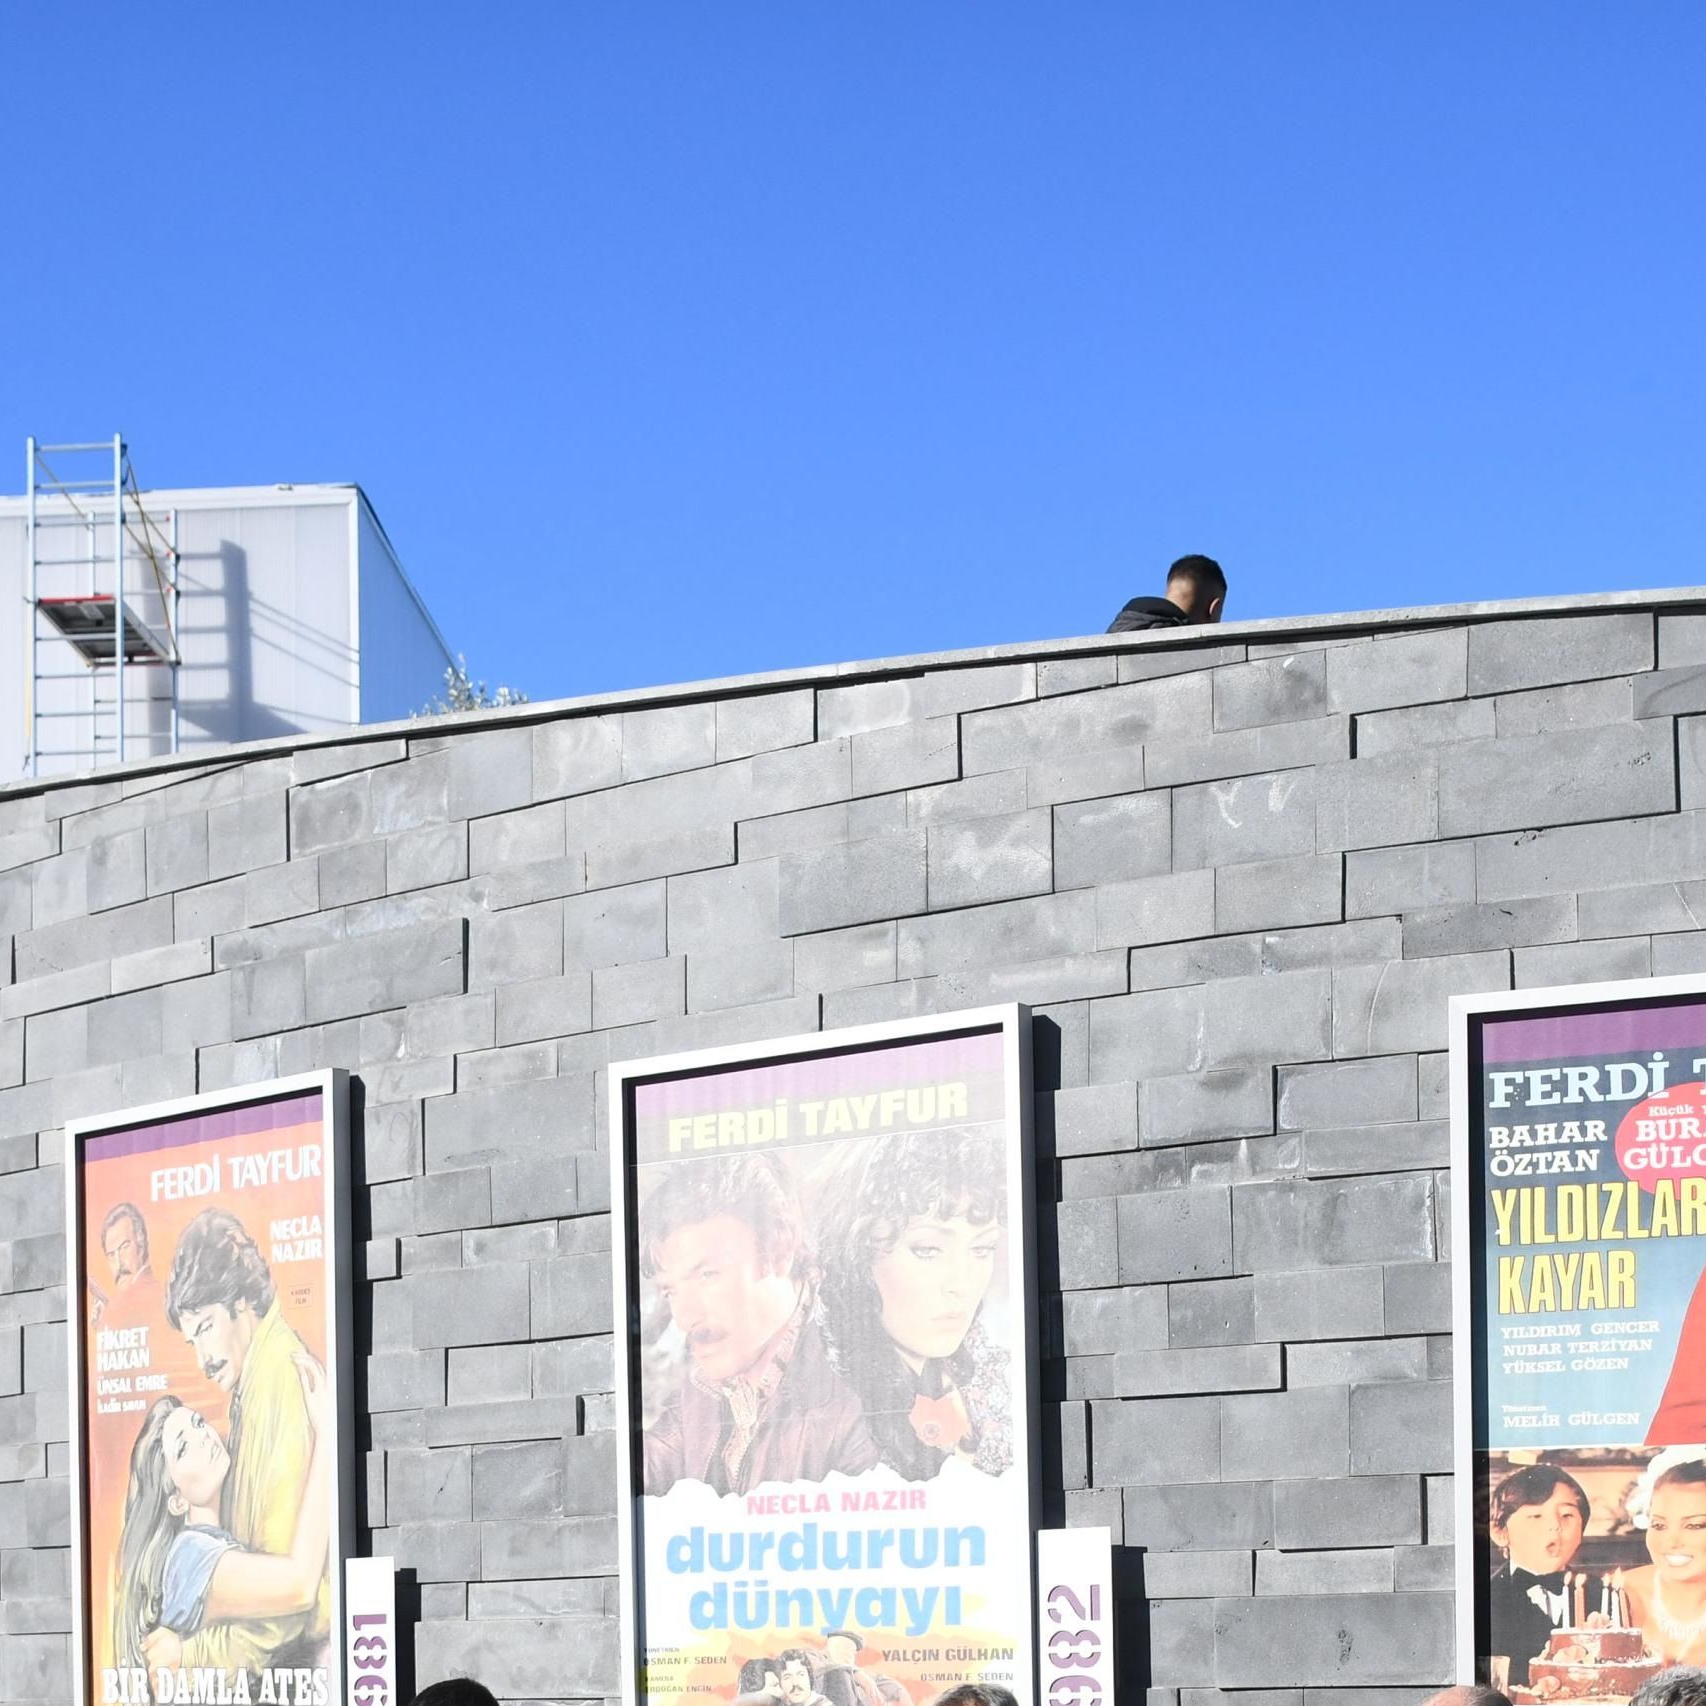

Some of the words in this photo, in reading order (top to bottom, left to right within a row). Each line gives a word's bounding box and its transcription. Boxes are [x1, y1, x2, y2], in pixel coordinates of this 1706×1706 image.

[1489, 1051, 1669, 1108] FERDİ
[669, 1099, 788, 1153] FERDİ
[799, 1082, 968, 1136] TAYFUR
[1648, 1103, 1694, 1117] Küçük
[1489, 1120, 1607, 1149] BAHAR
[151, 1153, 220, 1202] FERDİ
[228, 1144, 322, 1189] TAYFUR
[1490, 1147, 1598, 1177] ÖZTAN
[270, 1215, 323, 1241] NECLA
[271, 1238, 324, 1264] NAZIR
[1498, 1250, 1637, 1315] KAYAR
[97, 1324, 149, 1351] FİKRET
[1500, 1323, 1581, 1339] YILDIRIM
[97, 1347, 149, 1372] HAKAN
[1503, 1343, 1562, 1357] NUBAR
[1567, 1338, 1653, 1354] TERZİYAN
[1502, 1360, 1565, 1374] YÜKSEL
[1571, 1357, 1629, 1371] GÖZEN
[97, 1375, 132, 1395] ÜNSAL
[135, 1374, 168, 1392] EMRE
[1503, 1413, 1560, 1428] MELİH
[1568, 1411, 1640, 1426] GÜLGEN
[746, 1493, 831, 1516] NECLA
[841, 1489, 926, 1512] NAZIR
[666, 1522, 986, 1574] durdurun
[689, 1580, 962, 1637] dünyayı
[694, 1656, 727, 1664] SEDEN
[882, 1648, 939, 1664] YALÇIN
[945, 1646, 1013, 1661] GÜLHAN
[101, 1658, 150, 1704] BİR
[156, 1666, 252, 1705] DAMLA
[920, 1673, 962, 1681] OSMAN
[977, 1672, 1013, 1681] SEDEN
